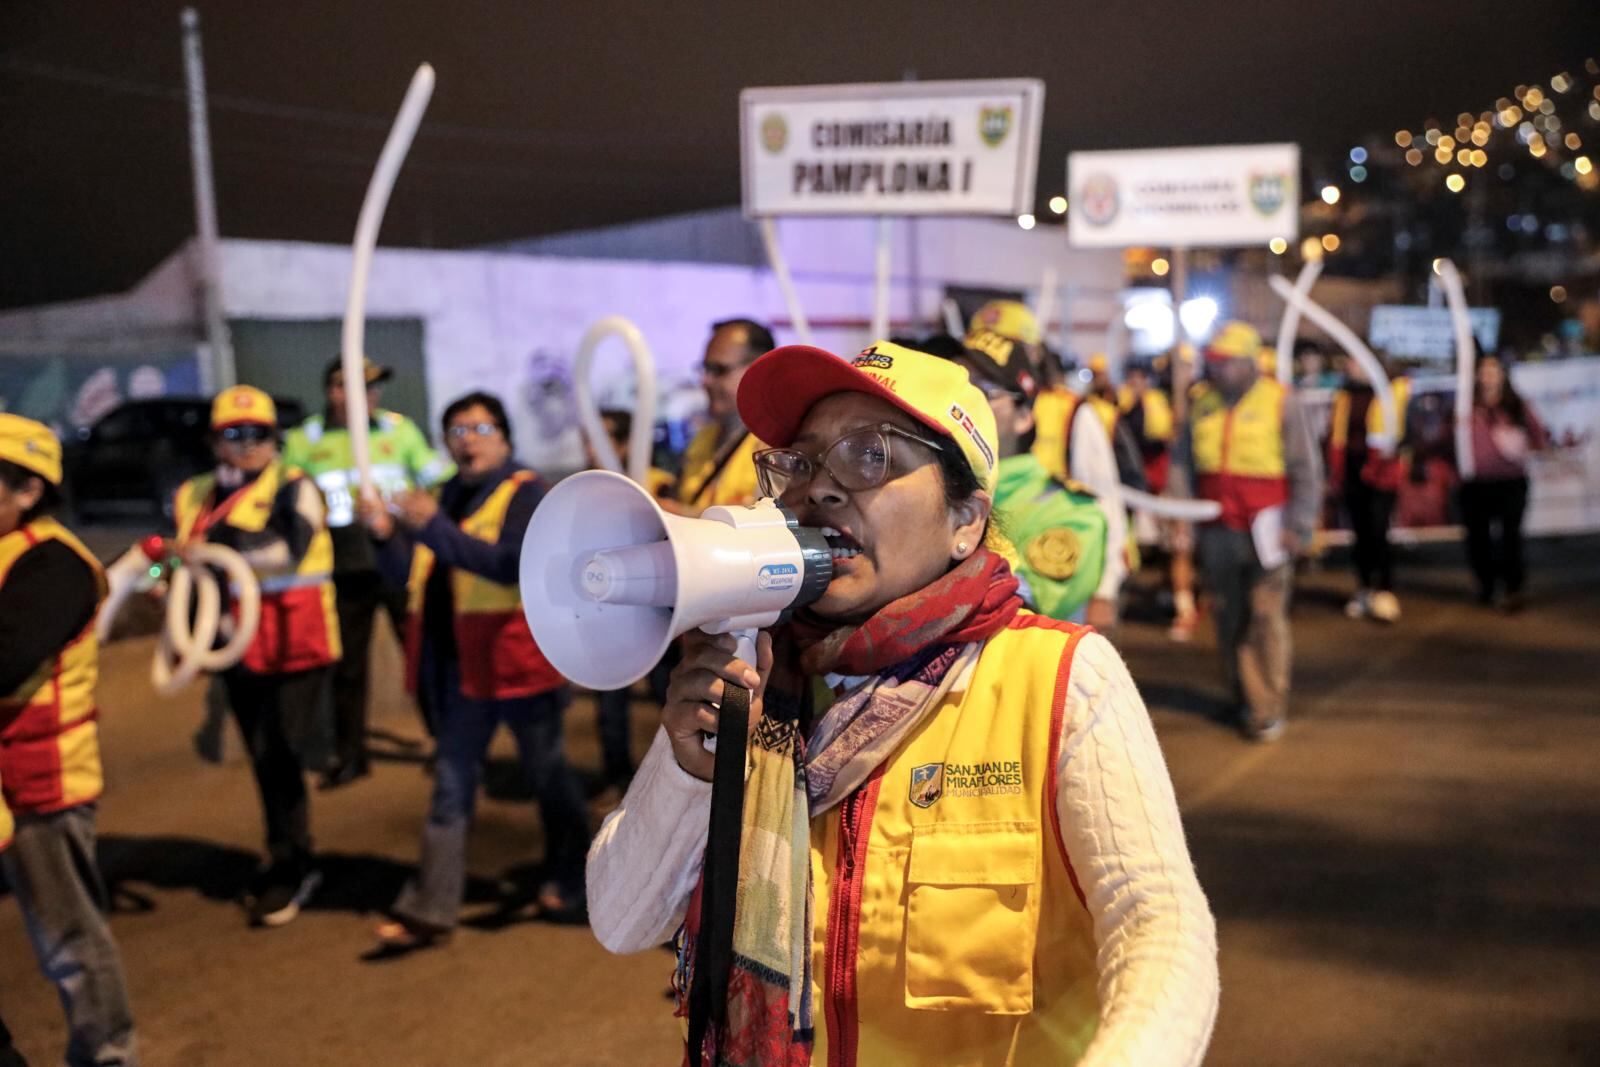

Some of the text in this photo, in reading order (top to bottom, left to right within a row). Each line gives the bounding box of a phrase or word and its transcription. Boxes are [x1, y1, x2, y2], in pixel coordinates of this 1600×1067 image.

[793, 161, 951, 193] PAMPLONA
[946, 761, 1020, 776] SAN JUAN DE
[946, 774, 1022, 788] MIRAFLORES
[946, 786, 1021, 797] MUNICIPALIDAD
